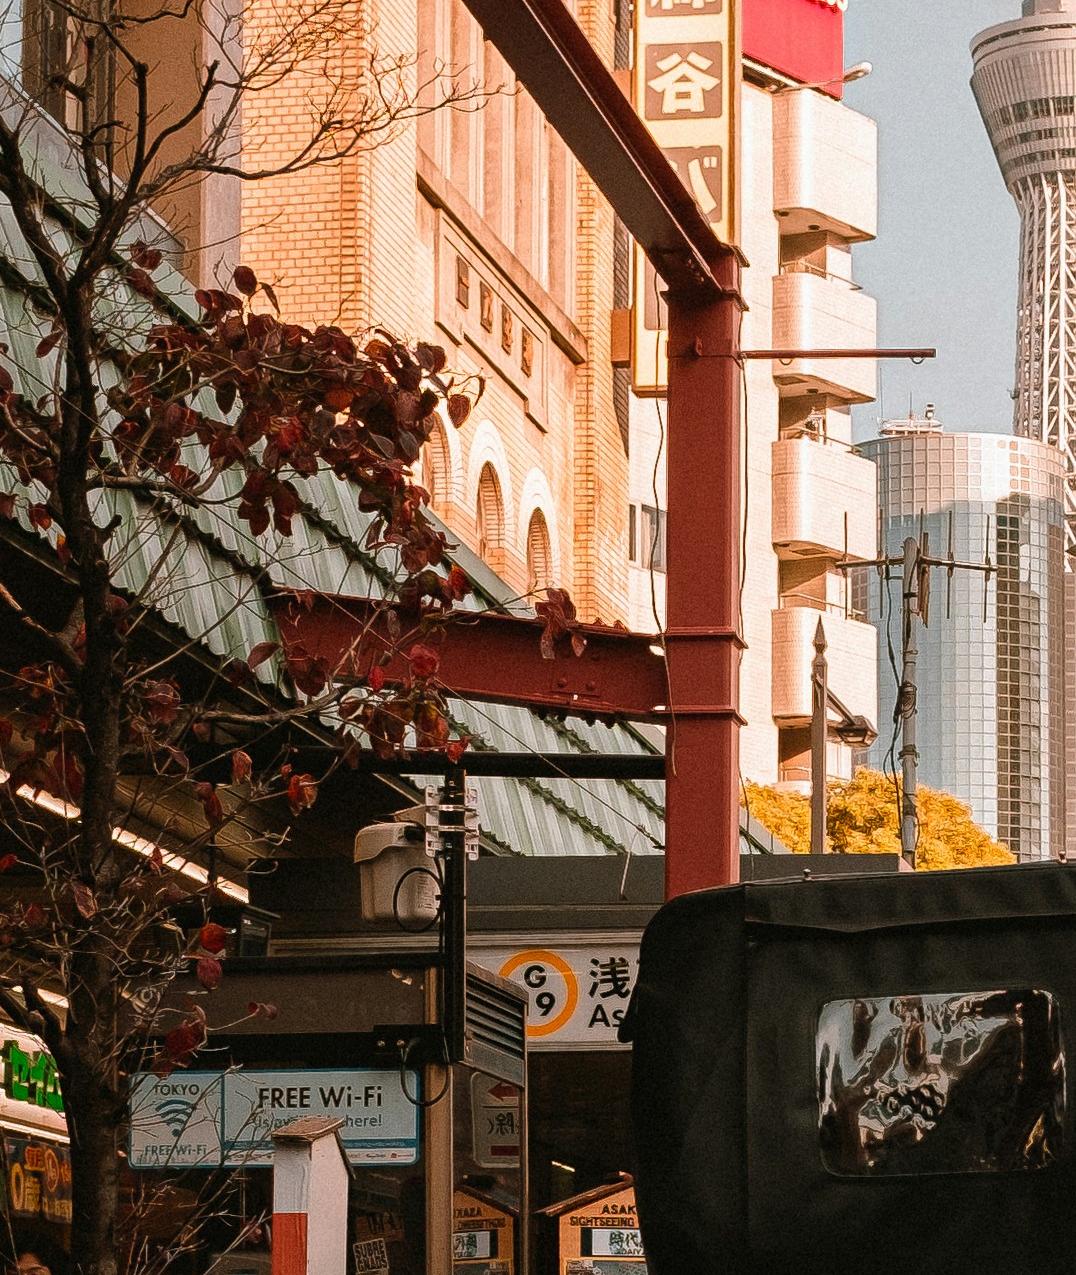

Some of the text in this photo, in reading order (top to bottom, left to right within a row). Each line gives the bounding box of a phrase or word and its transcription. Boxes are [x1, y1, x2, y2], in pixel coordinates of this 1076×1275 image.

[524, 965, 547, 988] G
[588, 957, 639, 998] 浅
[526, 992, 556, 1016] 9
[154, 1083, 200, 1096] TOKYO
[258, 1085, 383, 1108] FREE Wi-Fi
[570, 1216, 634, 1227] SIGHTSEEING
